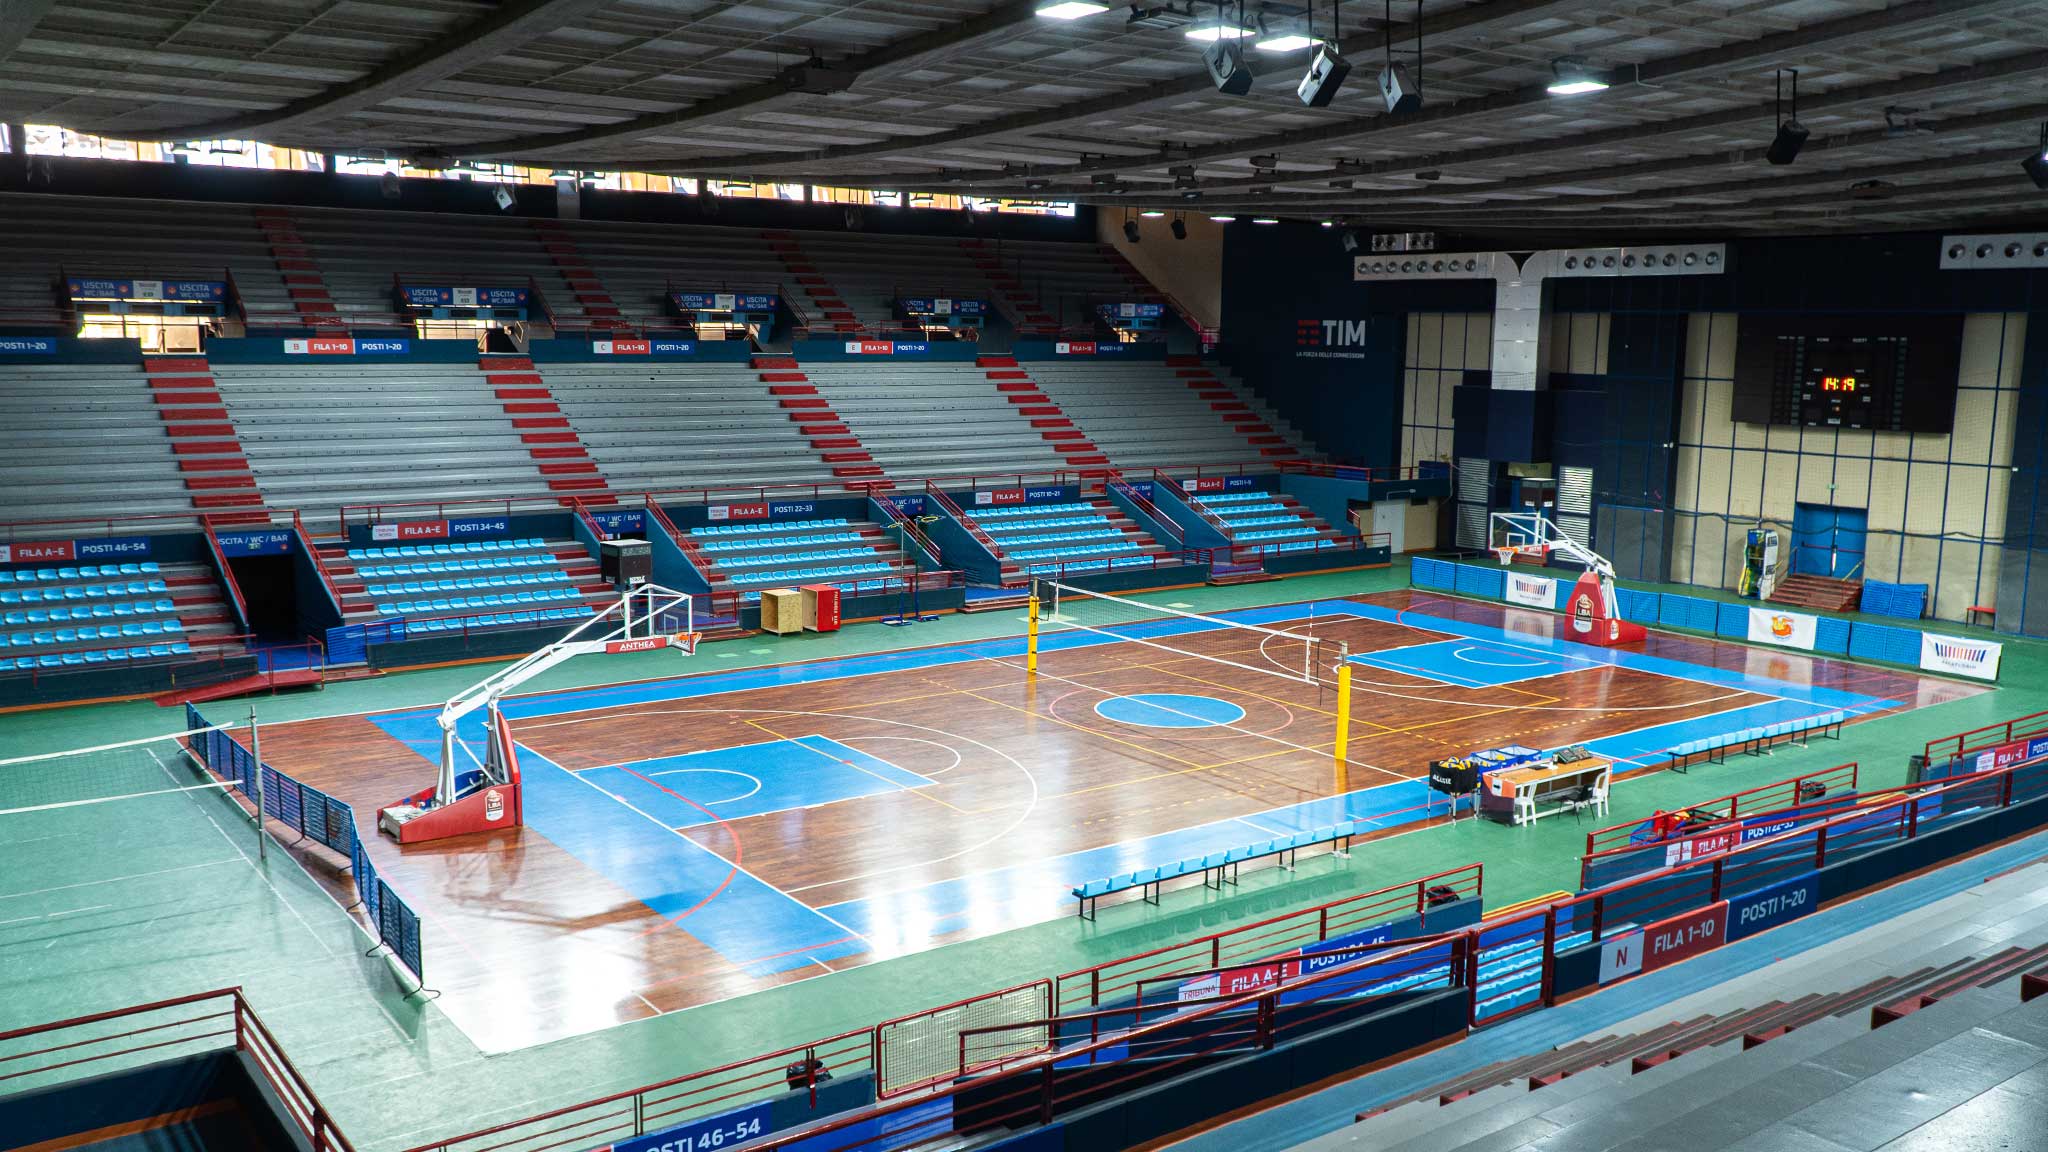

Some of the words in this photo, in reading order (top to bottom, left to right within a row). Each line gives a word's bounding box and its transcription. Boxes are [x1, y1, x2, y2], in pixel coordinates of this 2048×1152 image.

[1323, 320, 1365, 346] TIM
[26, 342, 47, 350] 1-20
[1824, 378, 1855, 390] 14:19
[455, 524, 478, 532] POSTI
[20, 549, 43, 557] FILA
[45, 548, 64, 556] A-E
[82, 544, 112, 553] POSTI
[114, 543, 146, 551] 46-54
[620, 641, 655, 651] ANTHEA
[1998, 752, 2010, 764] FILA
[1699, 840, 1716, 854] FILA
[1616, 946, 1627, 968] N
[1654, 929, 1683, 954] FILA
[1688, 919, 1714, 943] 1-10
[1741, 896, 1778, 925] POSTI
[1781, 888, 1807, 912] 1-20
[1184, 985, 1215, 1000] TRIBUNA
[1232, 972, 1260, 993] FILA
[698, 1118, 760, 1149] 46-54
